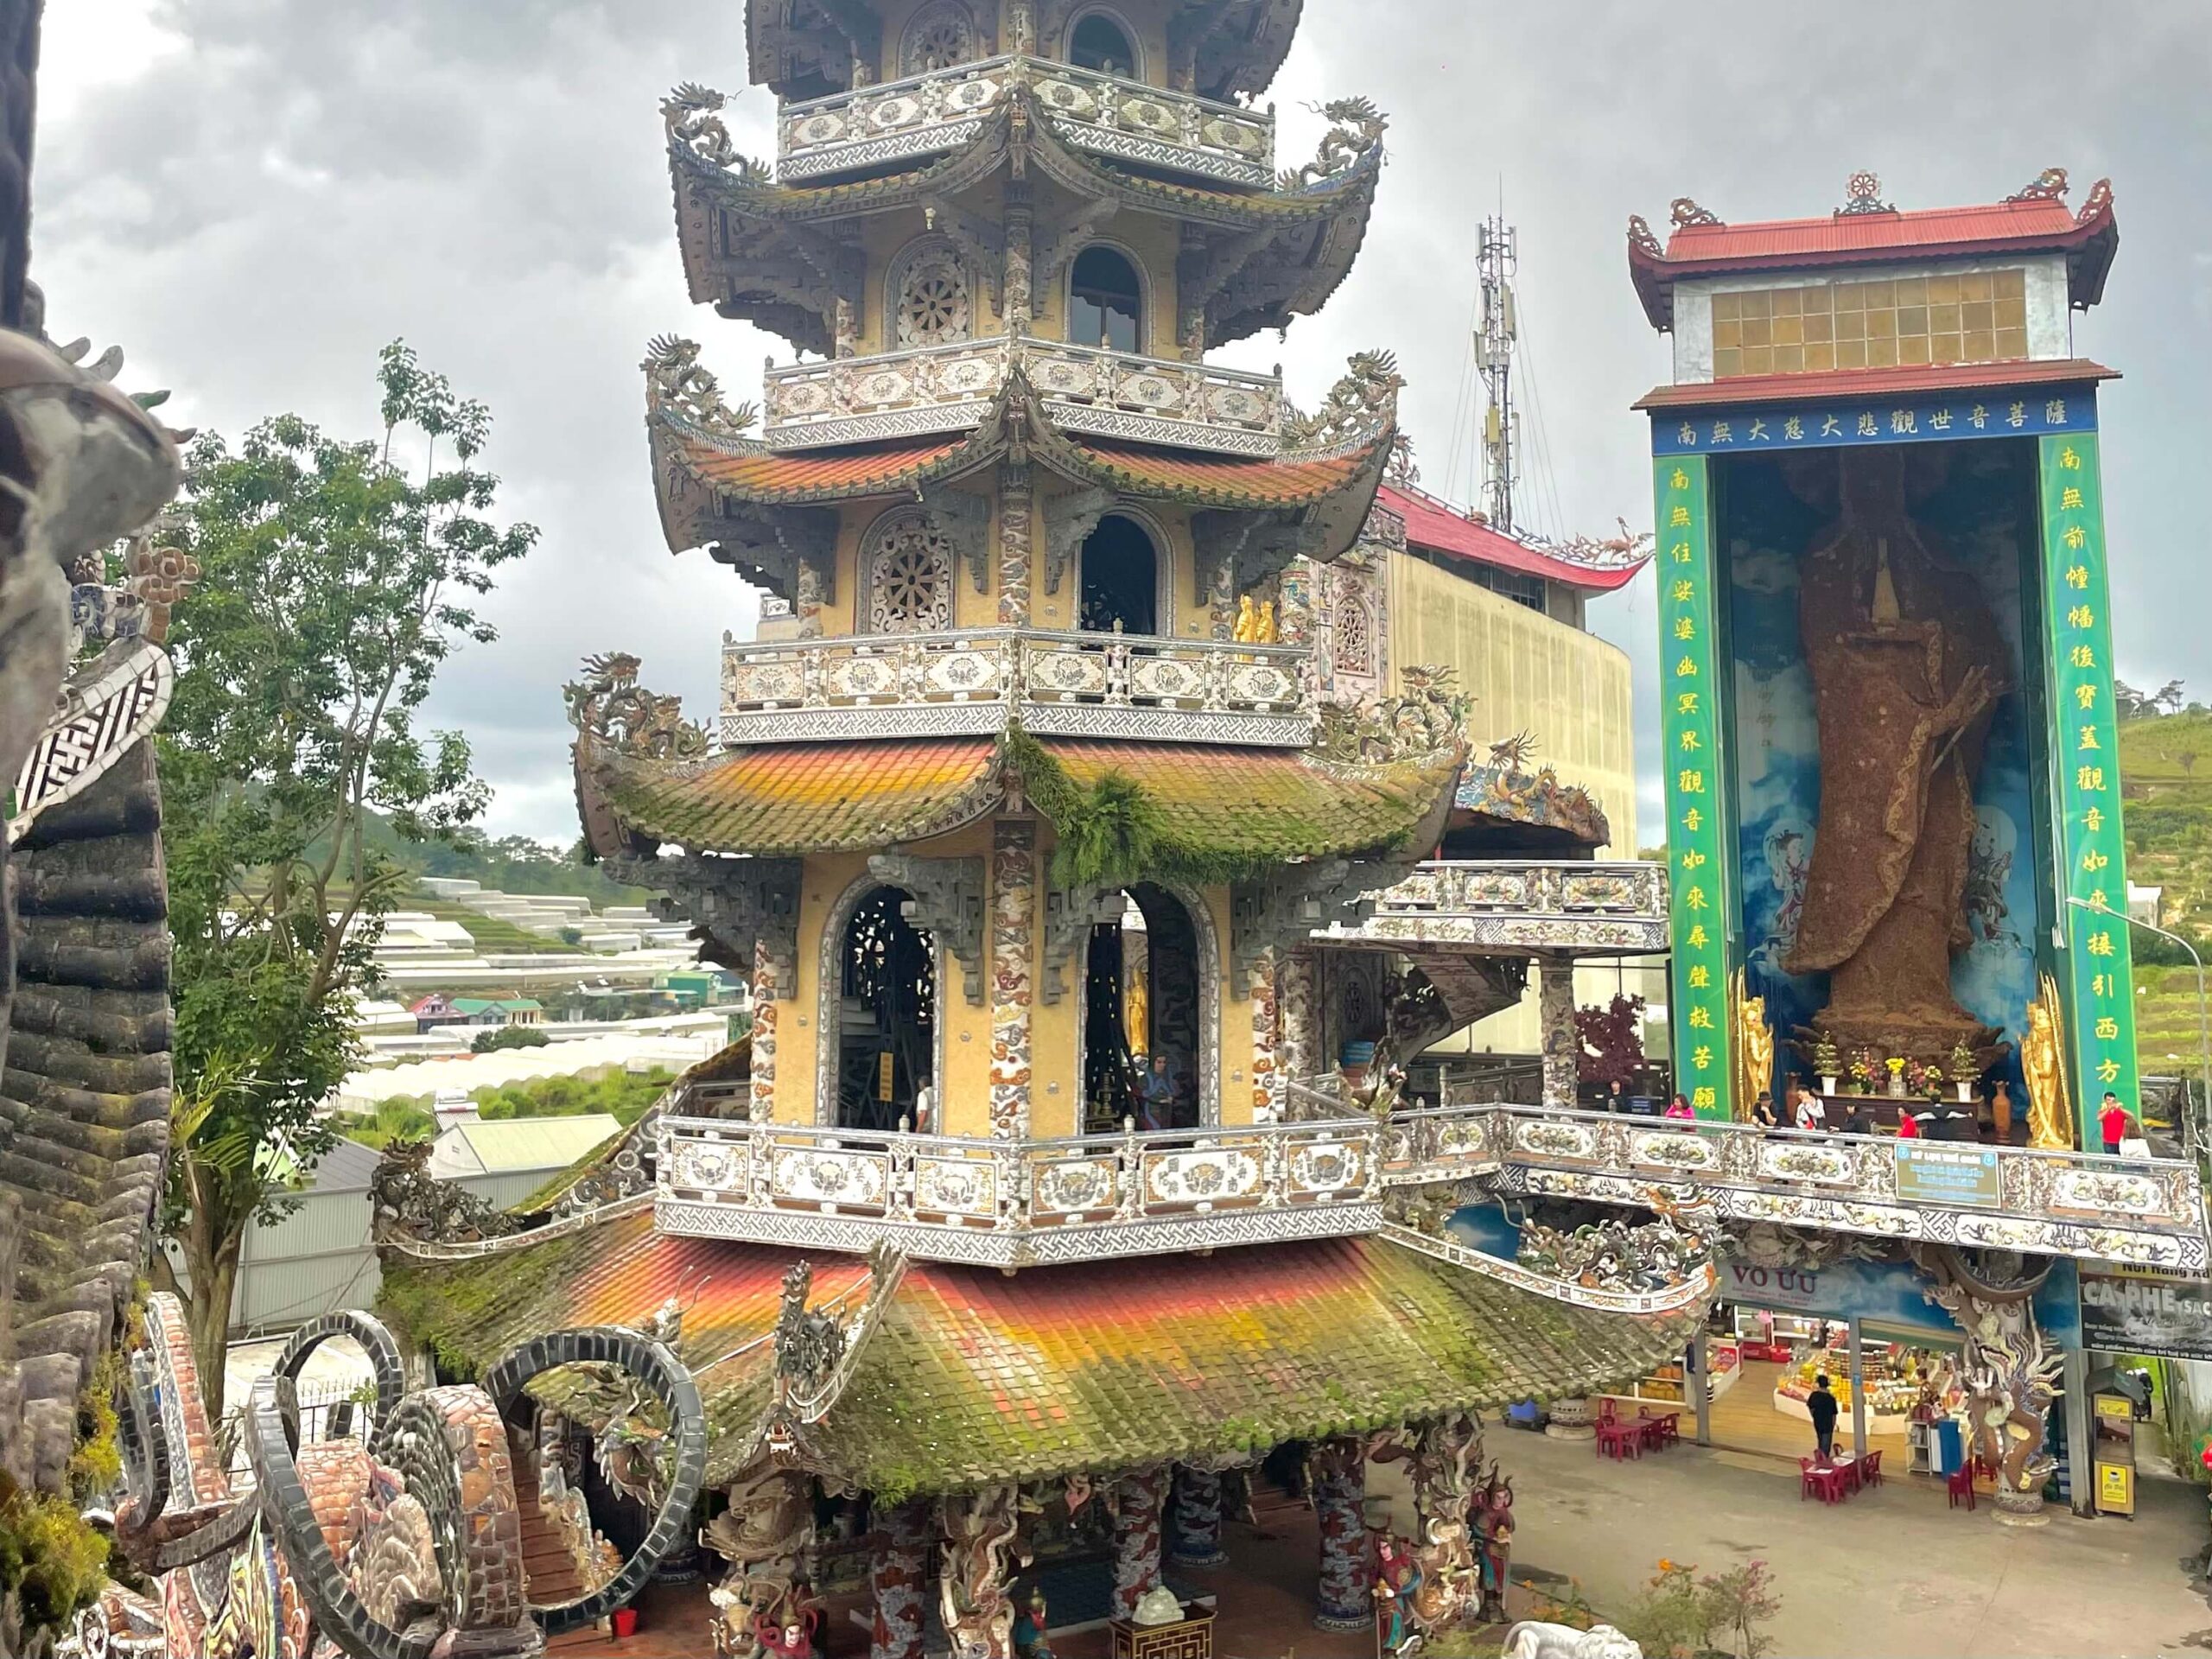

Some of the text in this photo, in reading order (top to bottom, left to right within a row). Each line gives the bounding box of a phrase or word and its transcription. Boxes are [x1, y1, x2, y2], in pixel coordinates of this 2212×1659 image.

[1676, 399, 2069, 446] 南無大慈大悲觀世音菩薩
[2059, 446, 2121, 1110] 南無前幢幡後寶蓋觀音如來接引西方
[2083, 1278, 2116, 1306] CÀ
[2125, 1282, 2176, 1312] PHÊ
